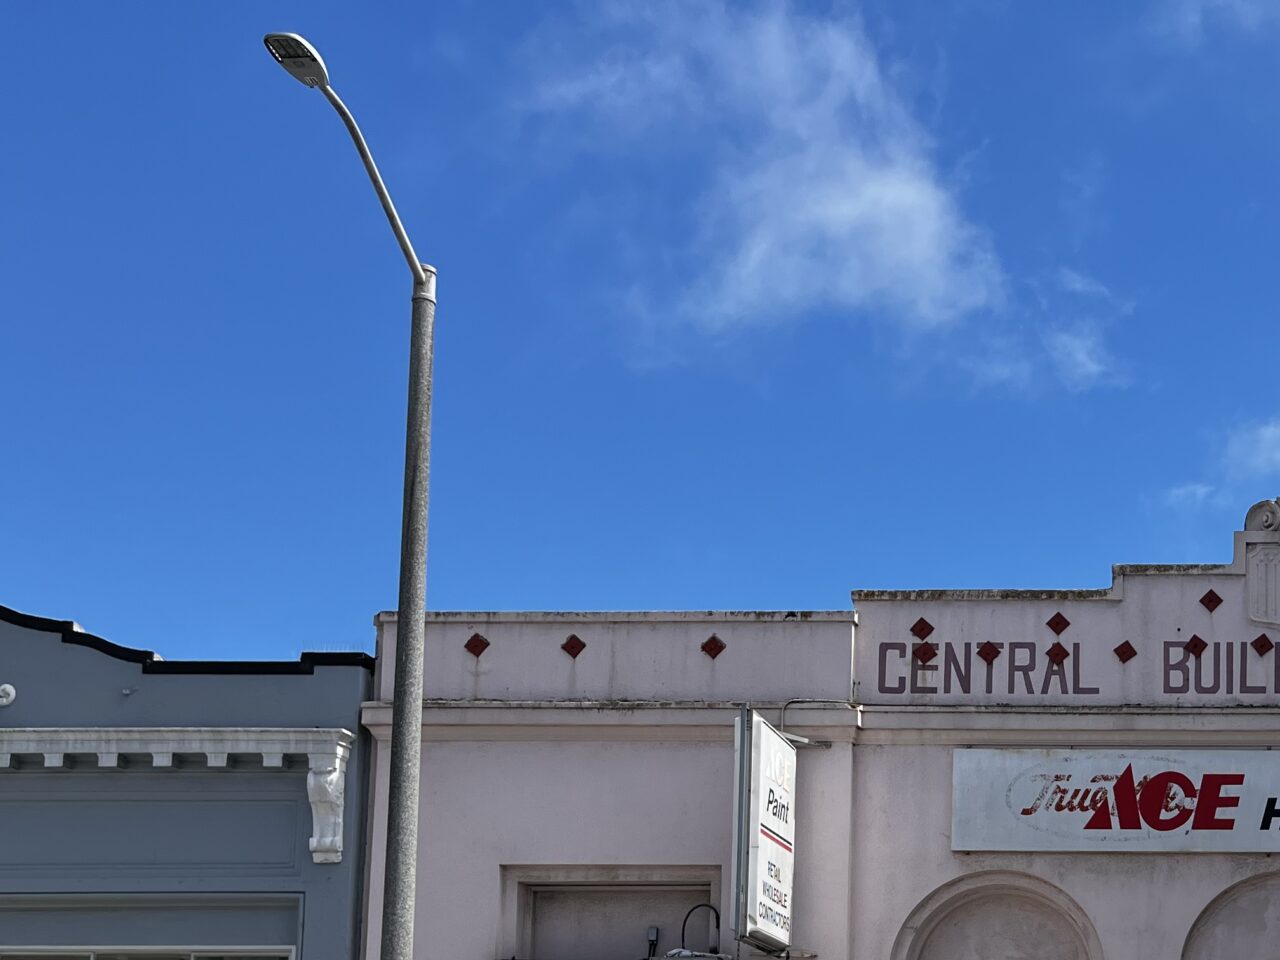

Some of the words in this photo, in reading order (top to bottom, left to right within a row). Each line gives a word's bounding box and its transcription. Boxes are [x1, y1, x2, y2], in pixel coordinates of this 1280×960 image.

[878, 641, 1100, 695] CENTRAL
[766, 788, 789, 824] Paint
[1083, 762, 1245, 831] ACE
[768, 861, 782, 883] RETAIL
[762, 880, 788, 909] WHOLESALE
[758, 901, 790, 933] CONTRACTORS
